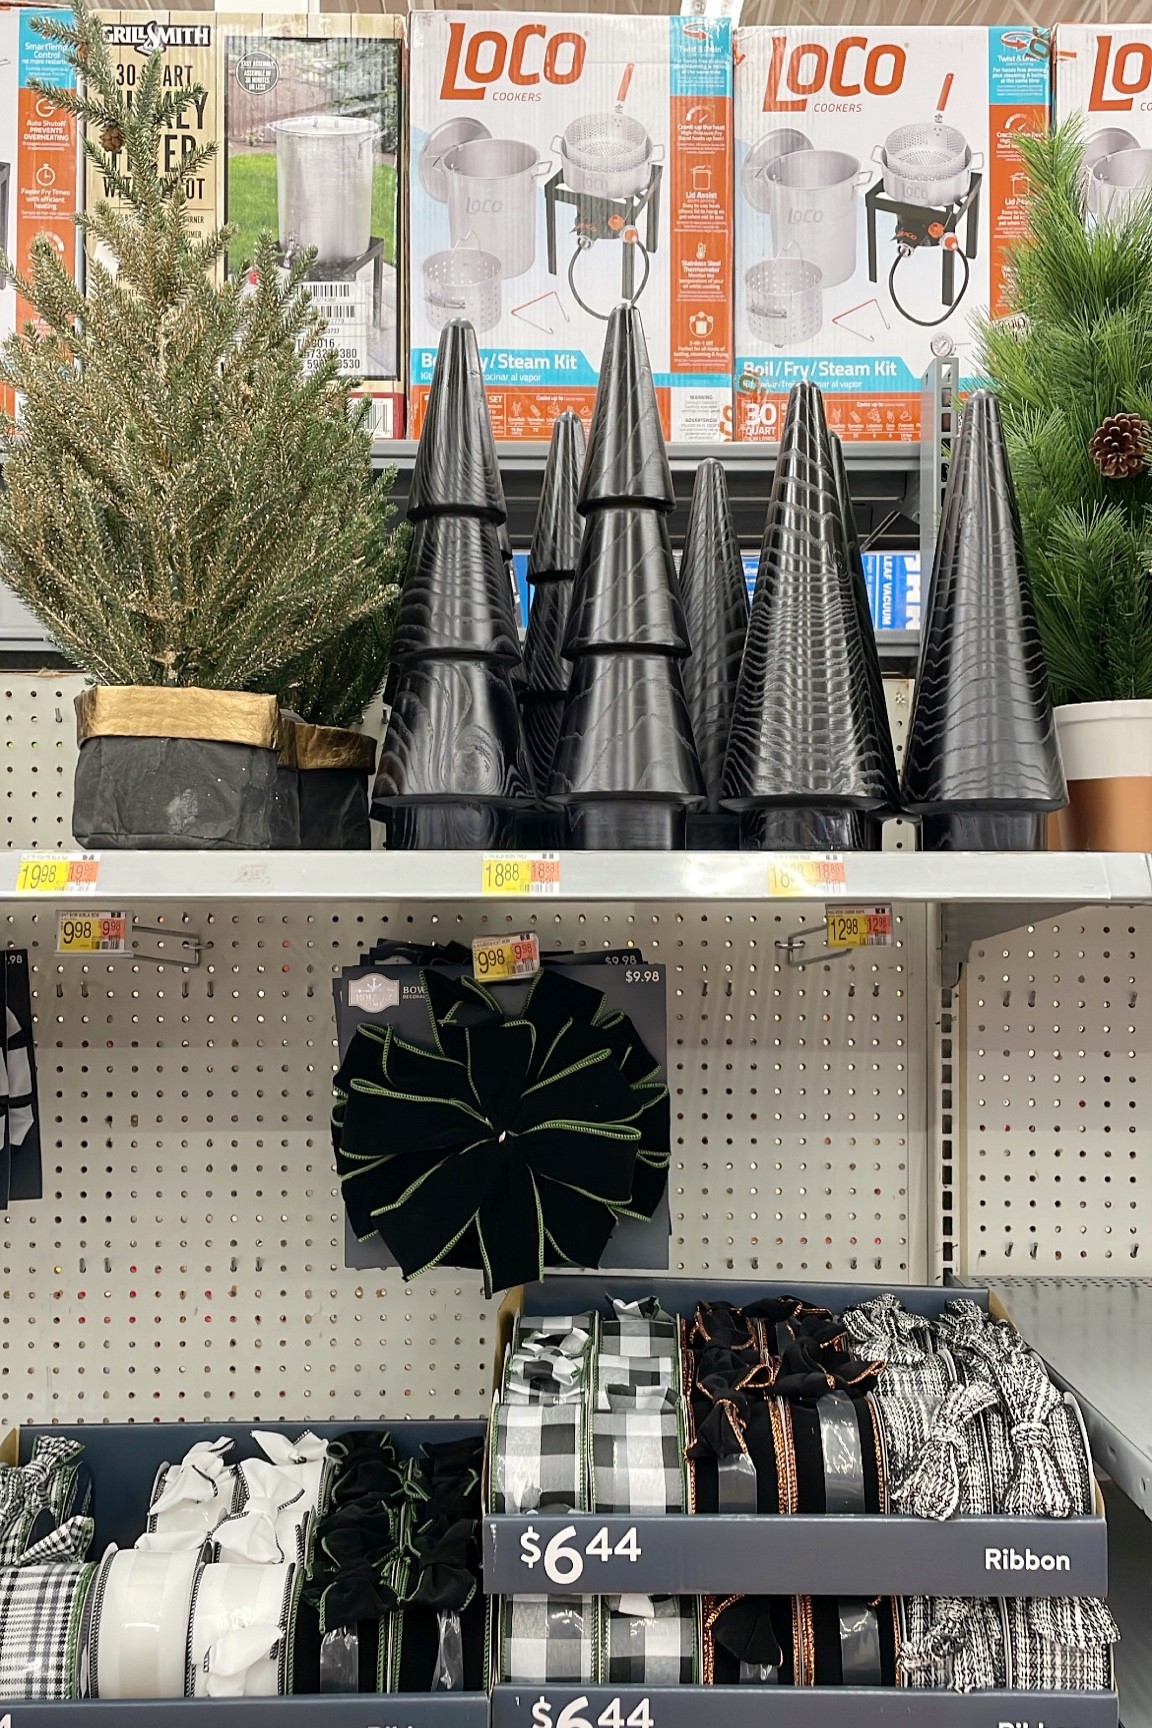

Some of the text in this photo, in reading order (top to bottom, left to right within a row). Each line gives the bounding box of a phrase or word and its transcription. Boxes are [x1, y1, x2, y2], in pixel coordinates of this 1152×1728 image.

[101, 23, 212, 56] GRILLSMITH
[492, 92, 542, 101] COOKERS
[813, 103, 862, 113] COOKERS
[554, 353, 577, 369] Kit
[874, 361, 897, 376] Kit
[519, 374, 542, 382] vapor
[840, 382, 863, 390] vapor
[489, 394, 503, 403] SET
[746, 426, 776, 436] QUART
[883, 555, 893, 580] LEAF
[882, 582, 892, 625] VACUUM
[63, 921, 92, 944] 998
[831, 918, 859, 941] 1298
[478, 949, 505, 974] 998
[625, 970, 660, 983] $9.98
[984, 1547, 1071, 1572] Ribbon
